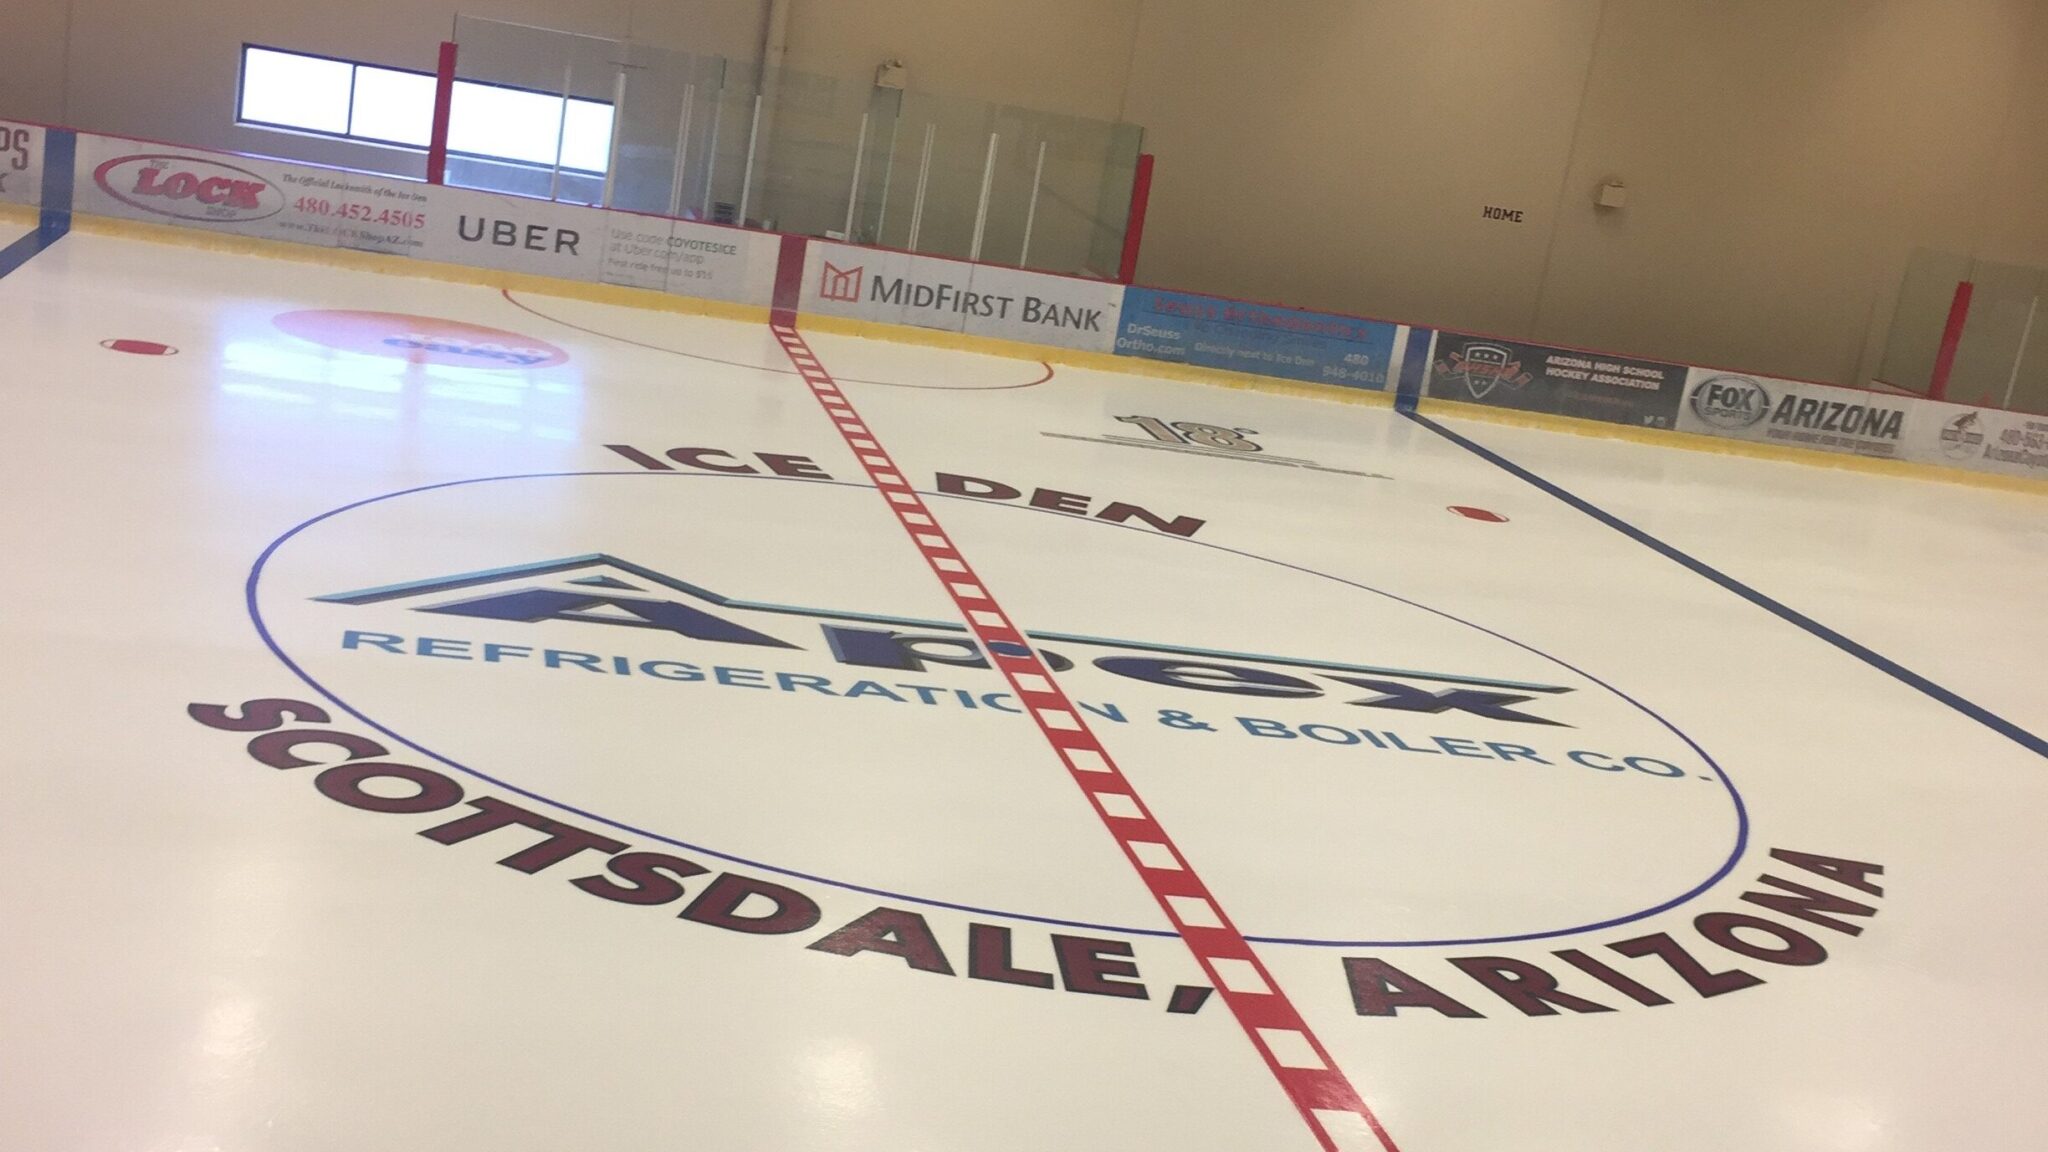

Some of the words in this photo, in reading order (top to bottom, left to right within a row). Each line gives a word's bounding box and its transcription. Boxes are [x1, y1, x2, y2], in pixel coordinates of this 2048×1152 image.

[132, 167, 266, 210] LOCK
[294, 197, 426, 229] 480.452.4505
[1482, 205, 1524, 223] HOME
[459, 215, 581, 256] UBER
[667, 236, 737, 256] COYOTESICE
[1127, 323, 1181, 340] DrSeuss
[1116, 337, 1185, 355] Ortho.com
[1545, 355, 1592, 369] ARIZONA
[1594, 361, 1621, 373] HIGH
[1622, 366, 1665, 379] SCHOOL
[1545, 366, 1591, 380] HOCKEY
[1591, 373, 1660, 390] ASSOCIATION
[1707, 384, 1757, 411] FOX
[1703, 406, 1752, 421] SPORTS
[1770, 394, 1905, 440] ARIZONA
[604, 444, 833, 480] ICE
[935, 472, 1206, 538] DEN
[1157, 710, 1218, 732] &
[1234, 716, 1555, 766] BOILER
[1566, 750, 1713, 782] CO.
[187, 698, 1215, 1014] SCOTTSDALE,
[1341, 847, 1884, 1019] ARIZONA
